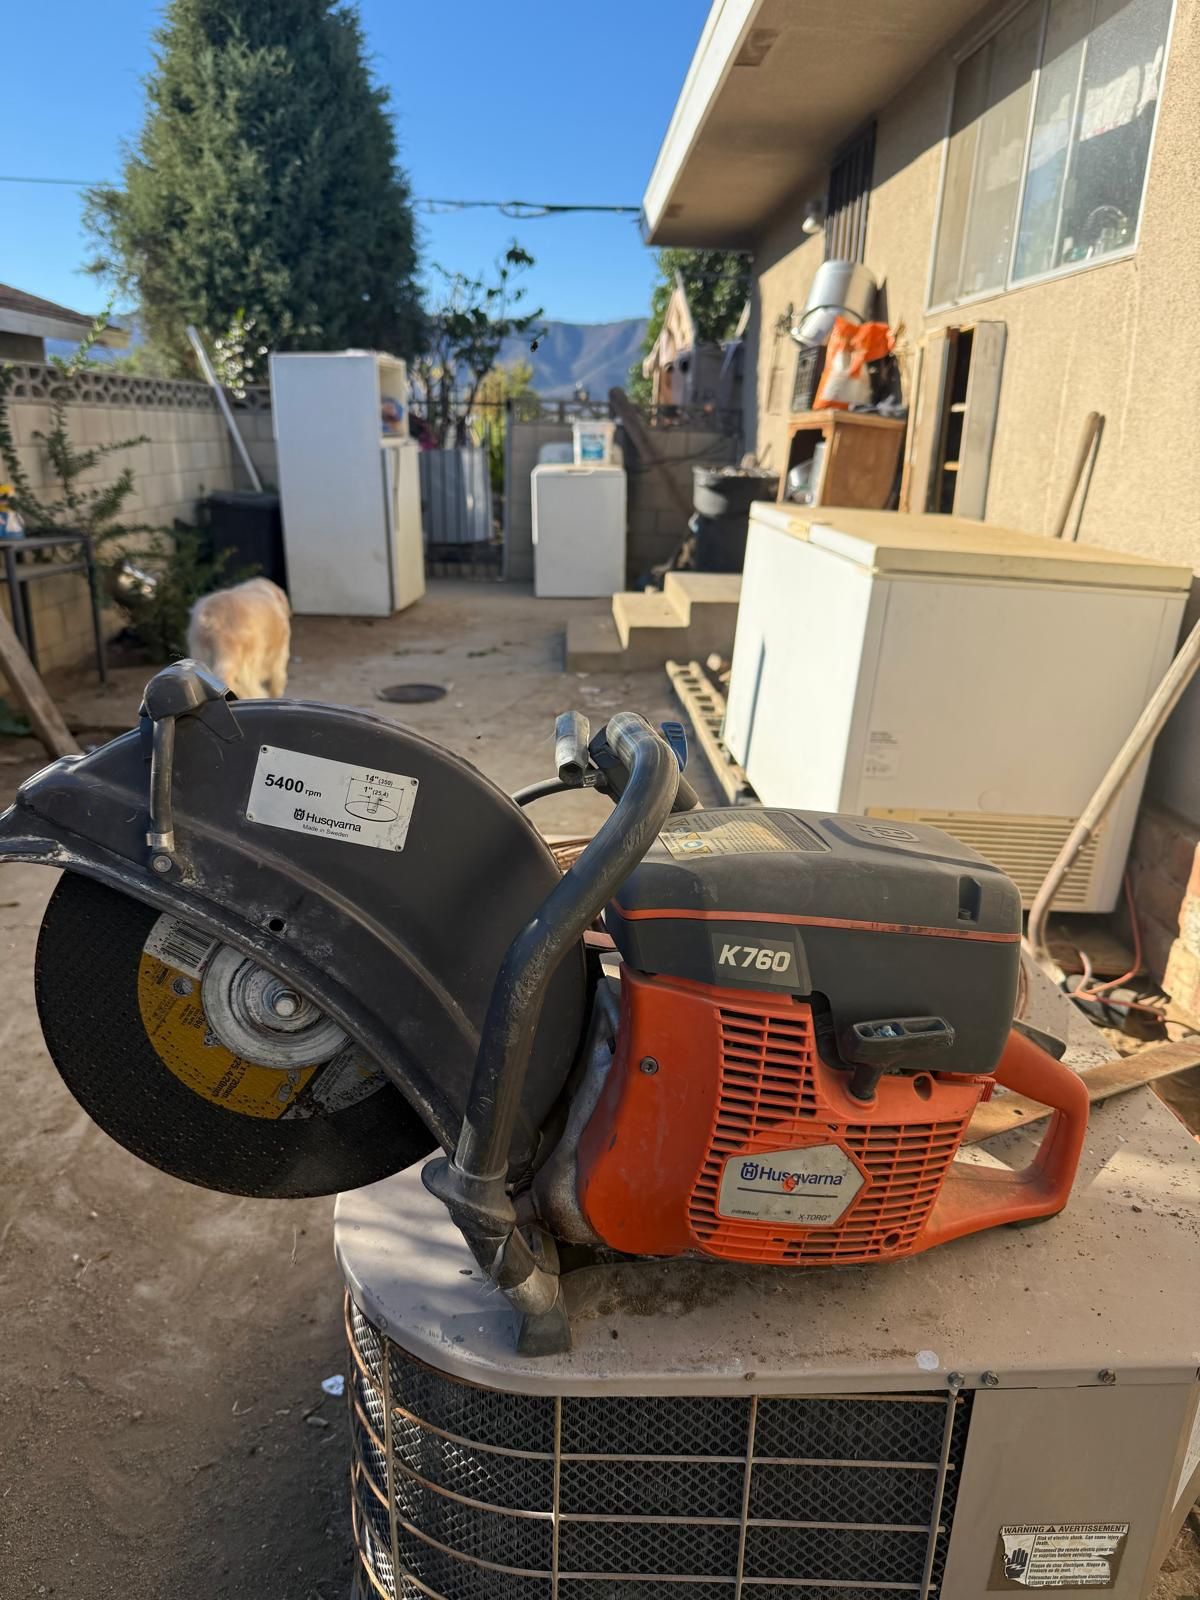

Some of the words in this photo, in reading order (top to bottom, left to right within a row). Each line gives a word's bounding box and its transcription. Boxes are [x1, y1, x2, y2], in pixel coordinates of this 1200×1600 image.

[264, 773, 304, 793] 5400
[305, 788, 322, 798] rpm
[302, 823, 318, 832] Made
[326, 828, 349, 838] Sweden
[305, 811, 362, 833] Husqvarna
[759, 1166, 843, 1186] Husqvarna
